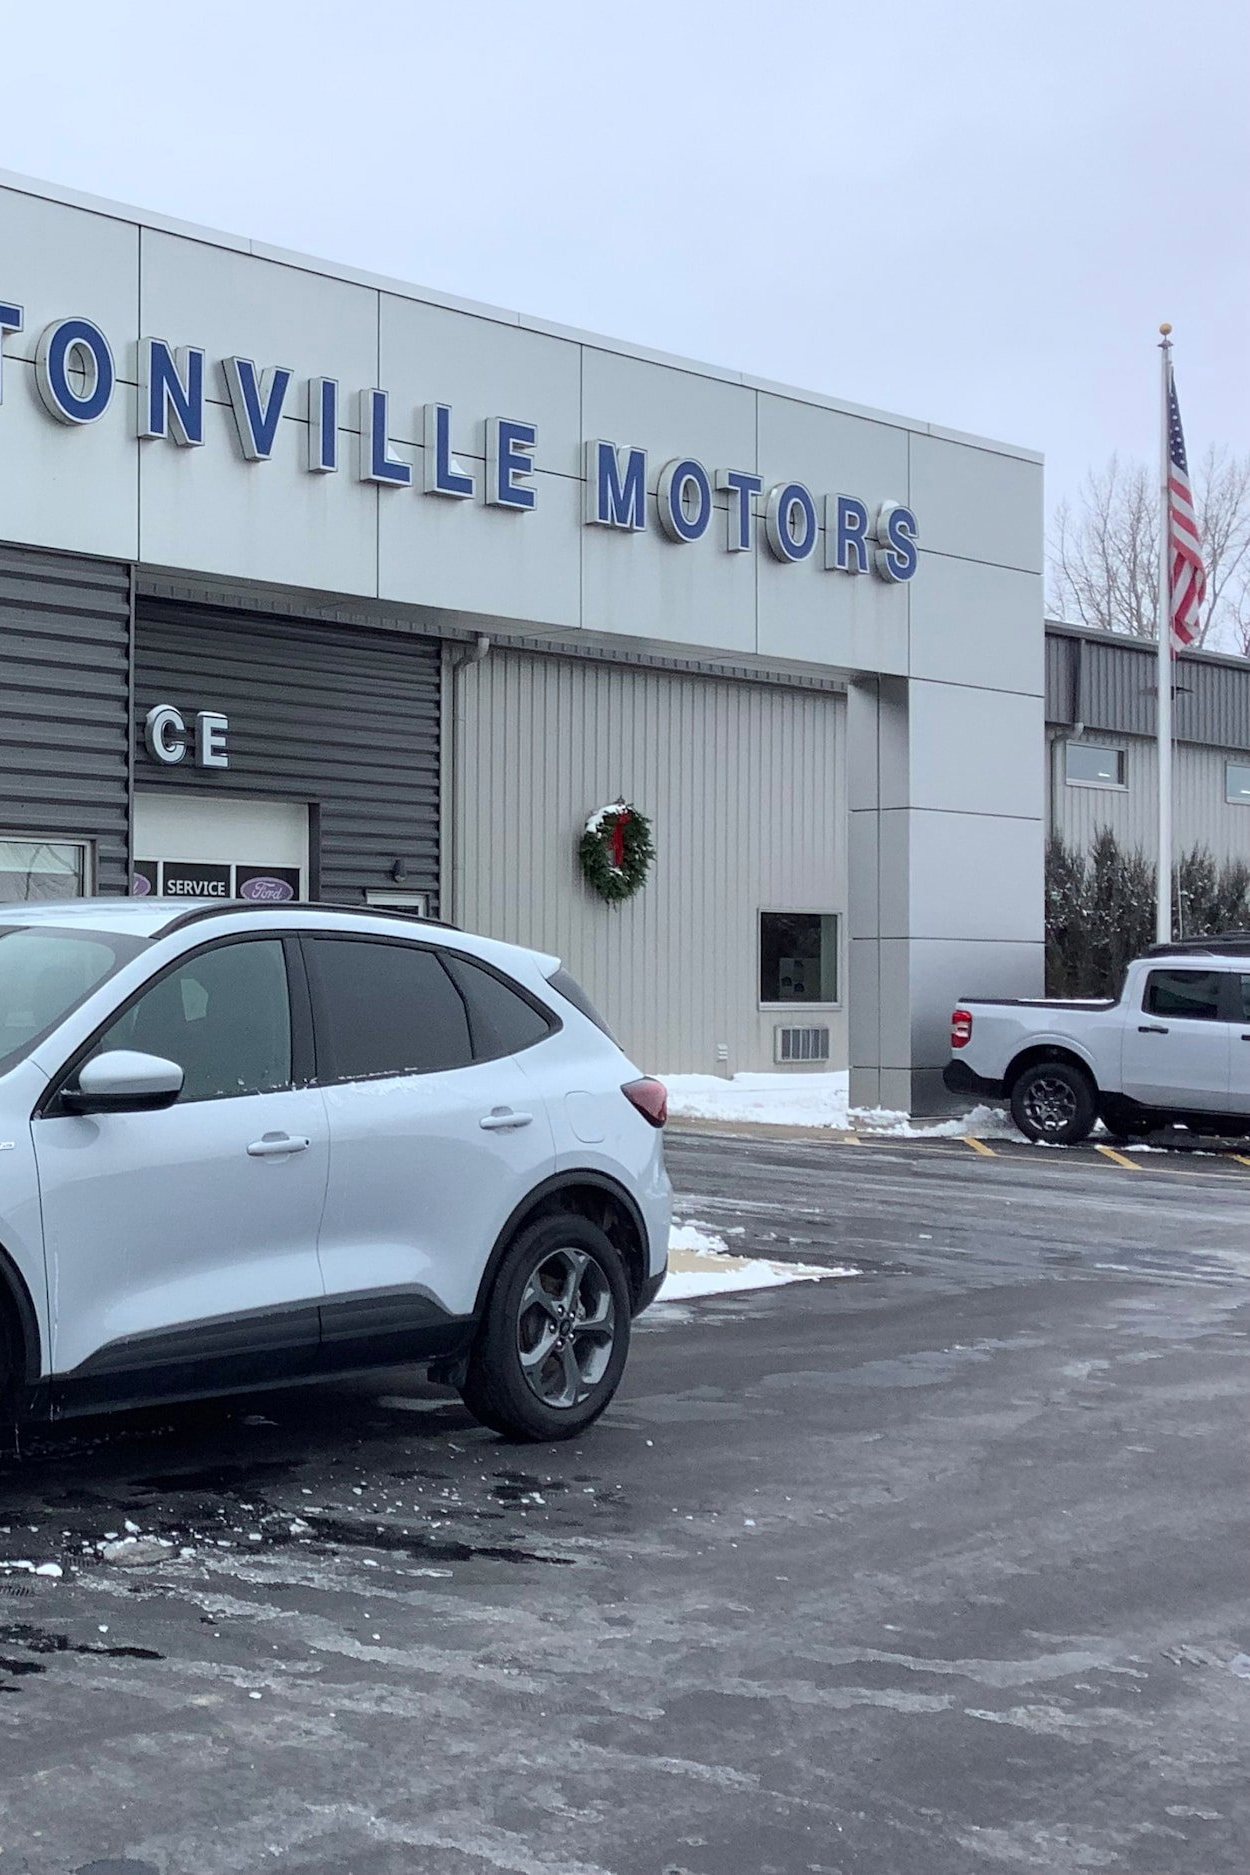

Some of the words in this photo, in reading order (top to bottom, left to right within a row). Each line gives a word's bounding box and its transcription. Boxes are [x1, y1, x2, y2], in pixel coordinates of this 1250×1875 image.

[586, 439, 920, 584] MOTORS
[167, 879, 226, 896] SERVICE
[251, 881, 284, 900] Ford
